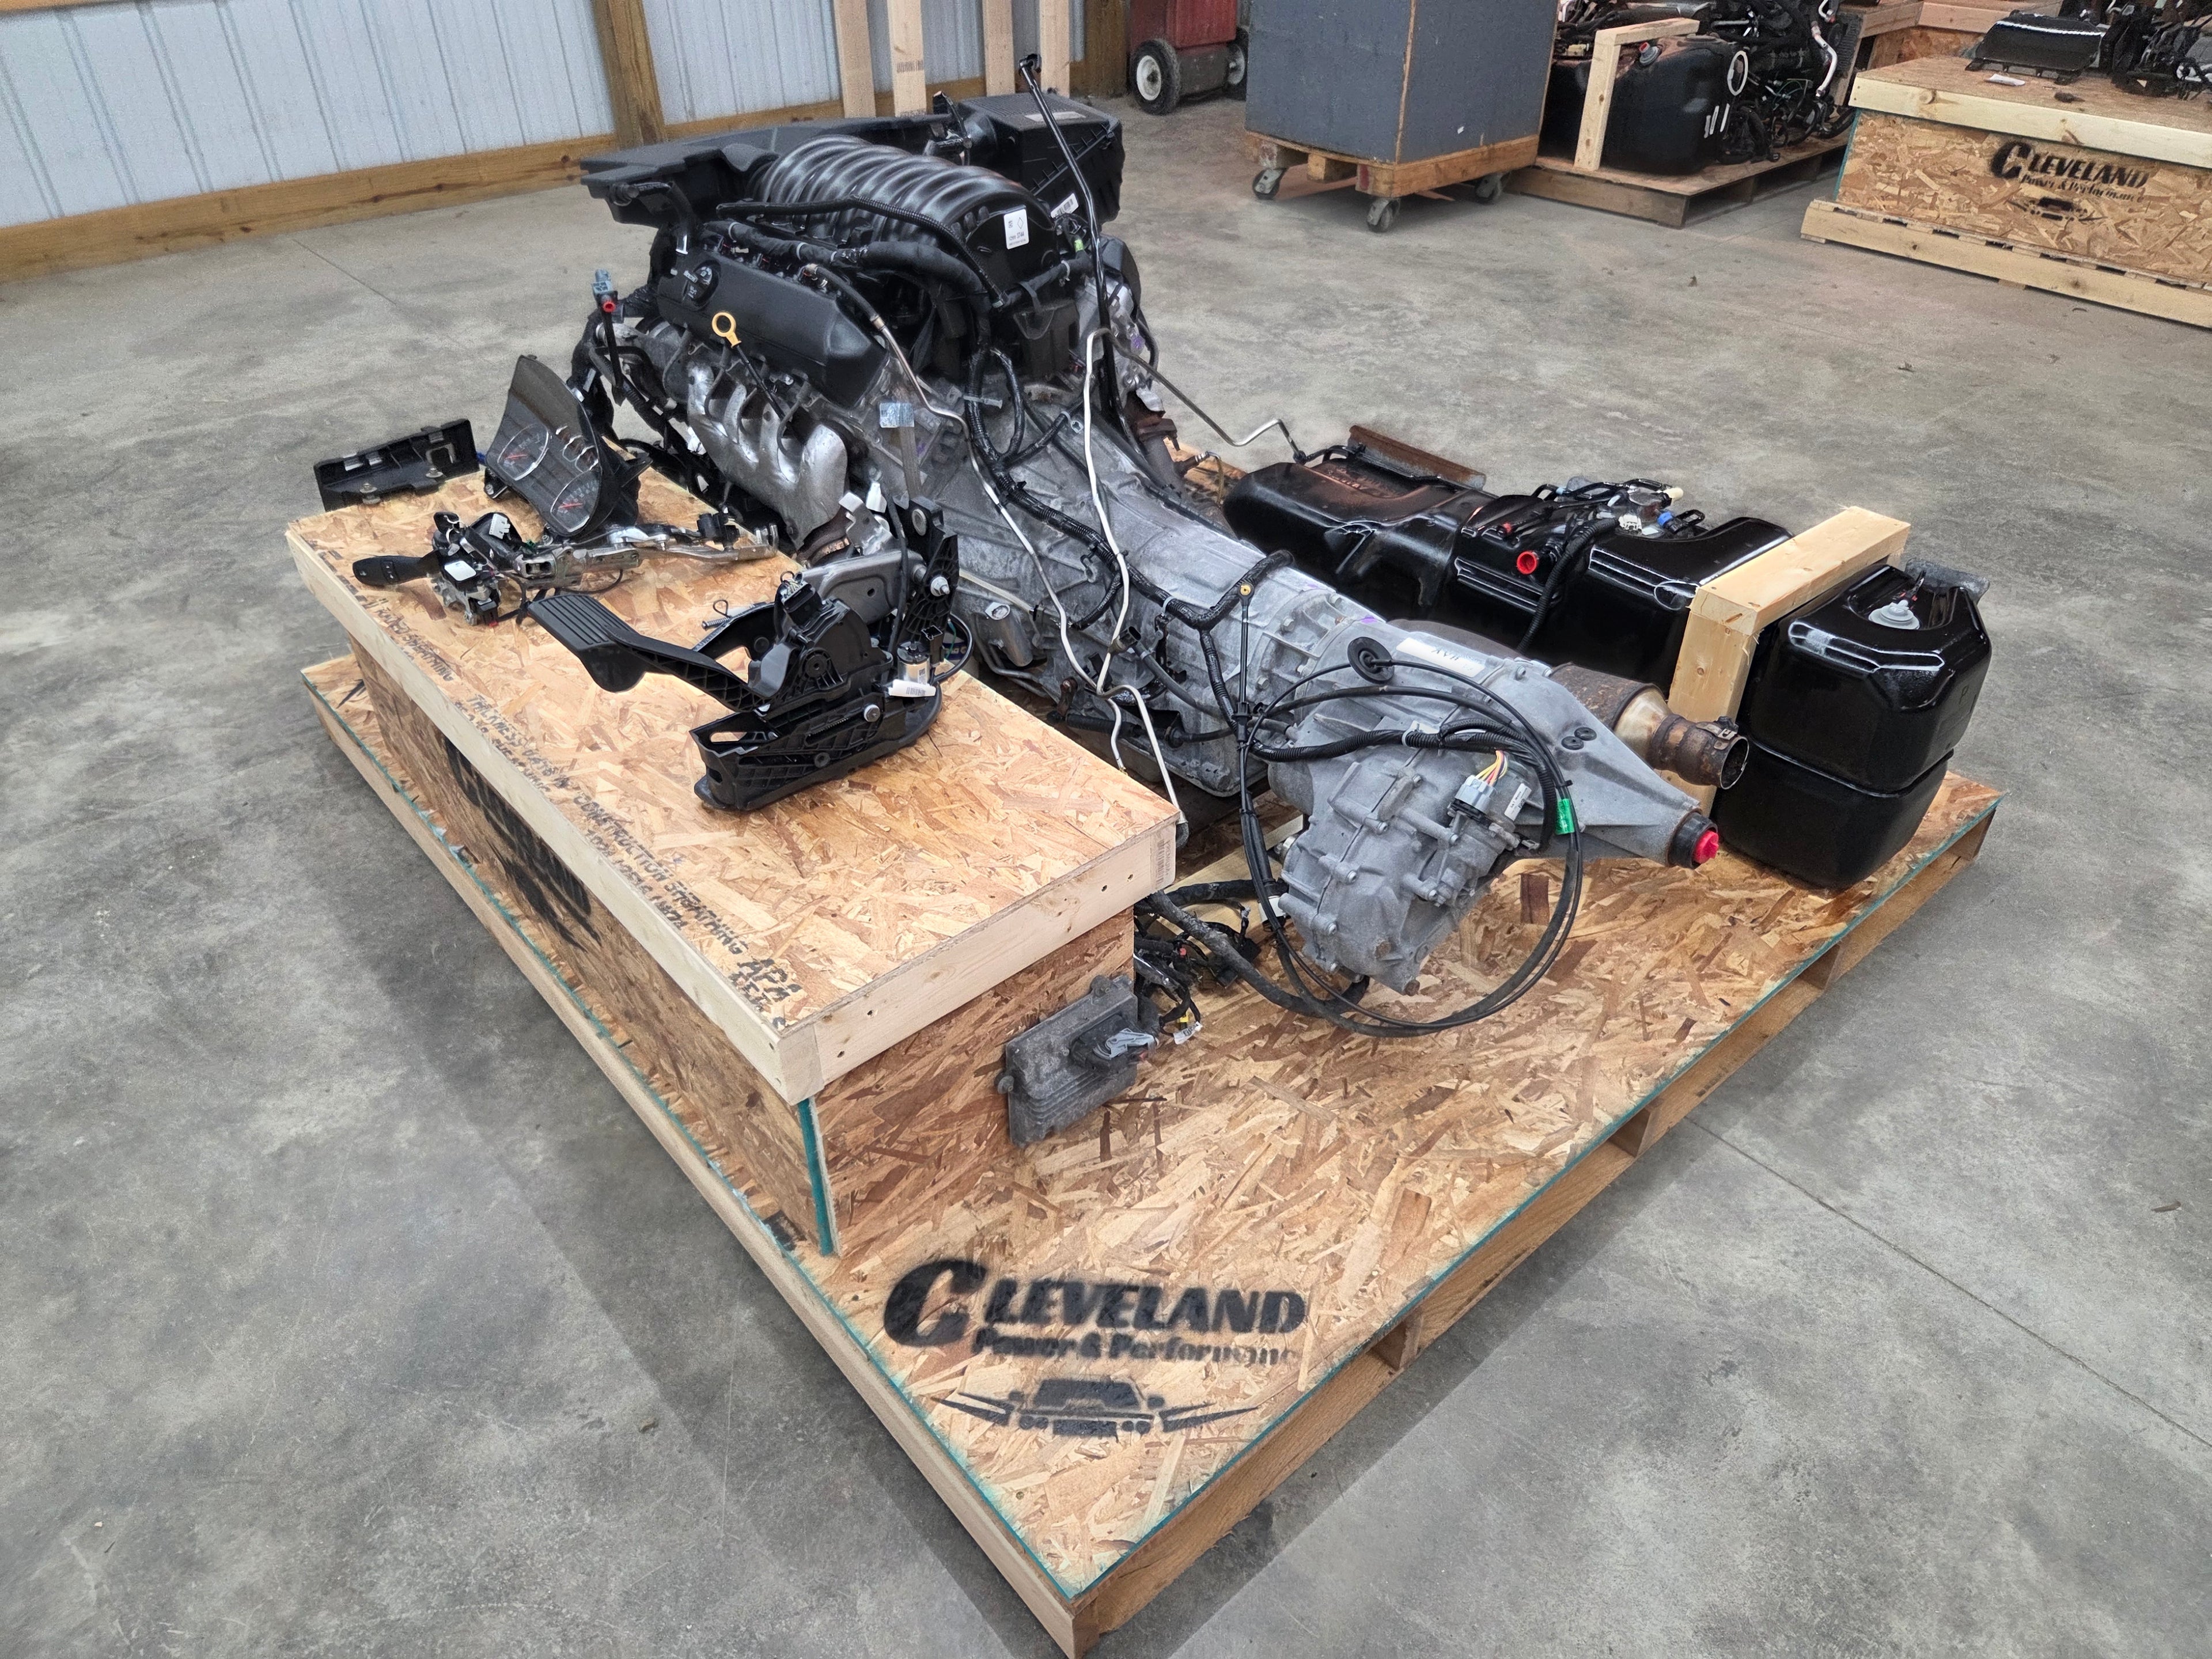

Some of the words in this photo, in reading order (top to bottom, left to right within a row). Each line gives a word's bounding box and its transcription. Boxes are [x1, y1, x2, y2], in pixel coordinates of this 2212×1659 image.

[1991, 141, 2150, 188] CLEVELAND
[882, 1259, 1306, 1348] CLEVELAND
[1080, 1332, 1101, 1359] &
